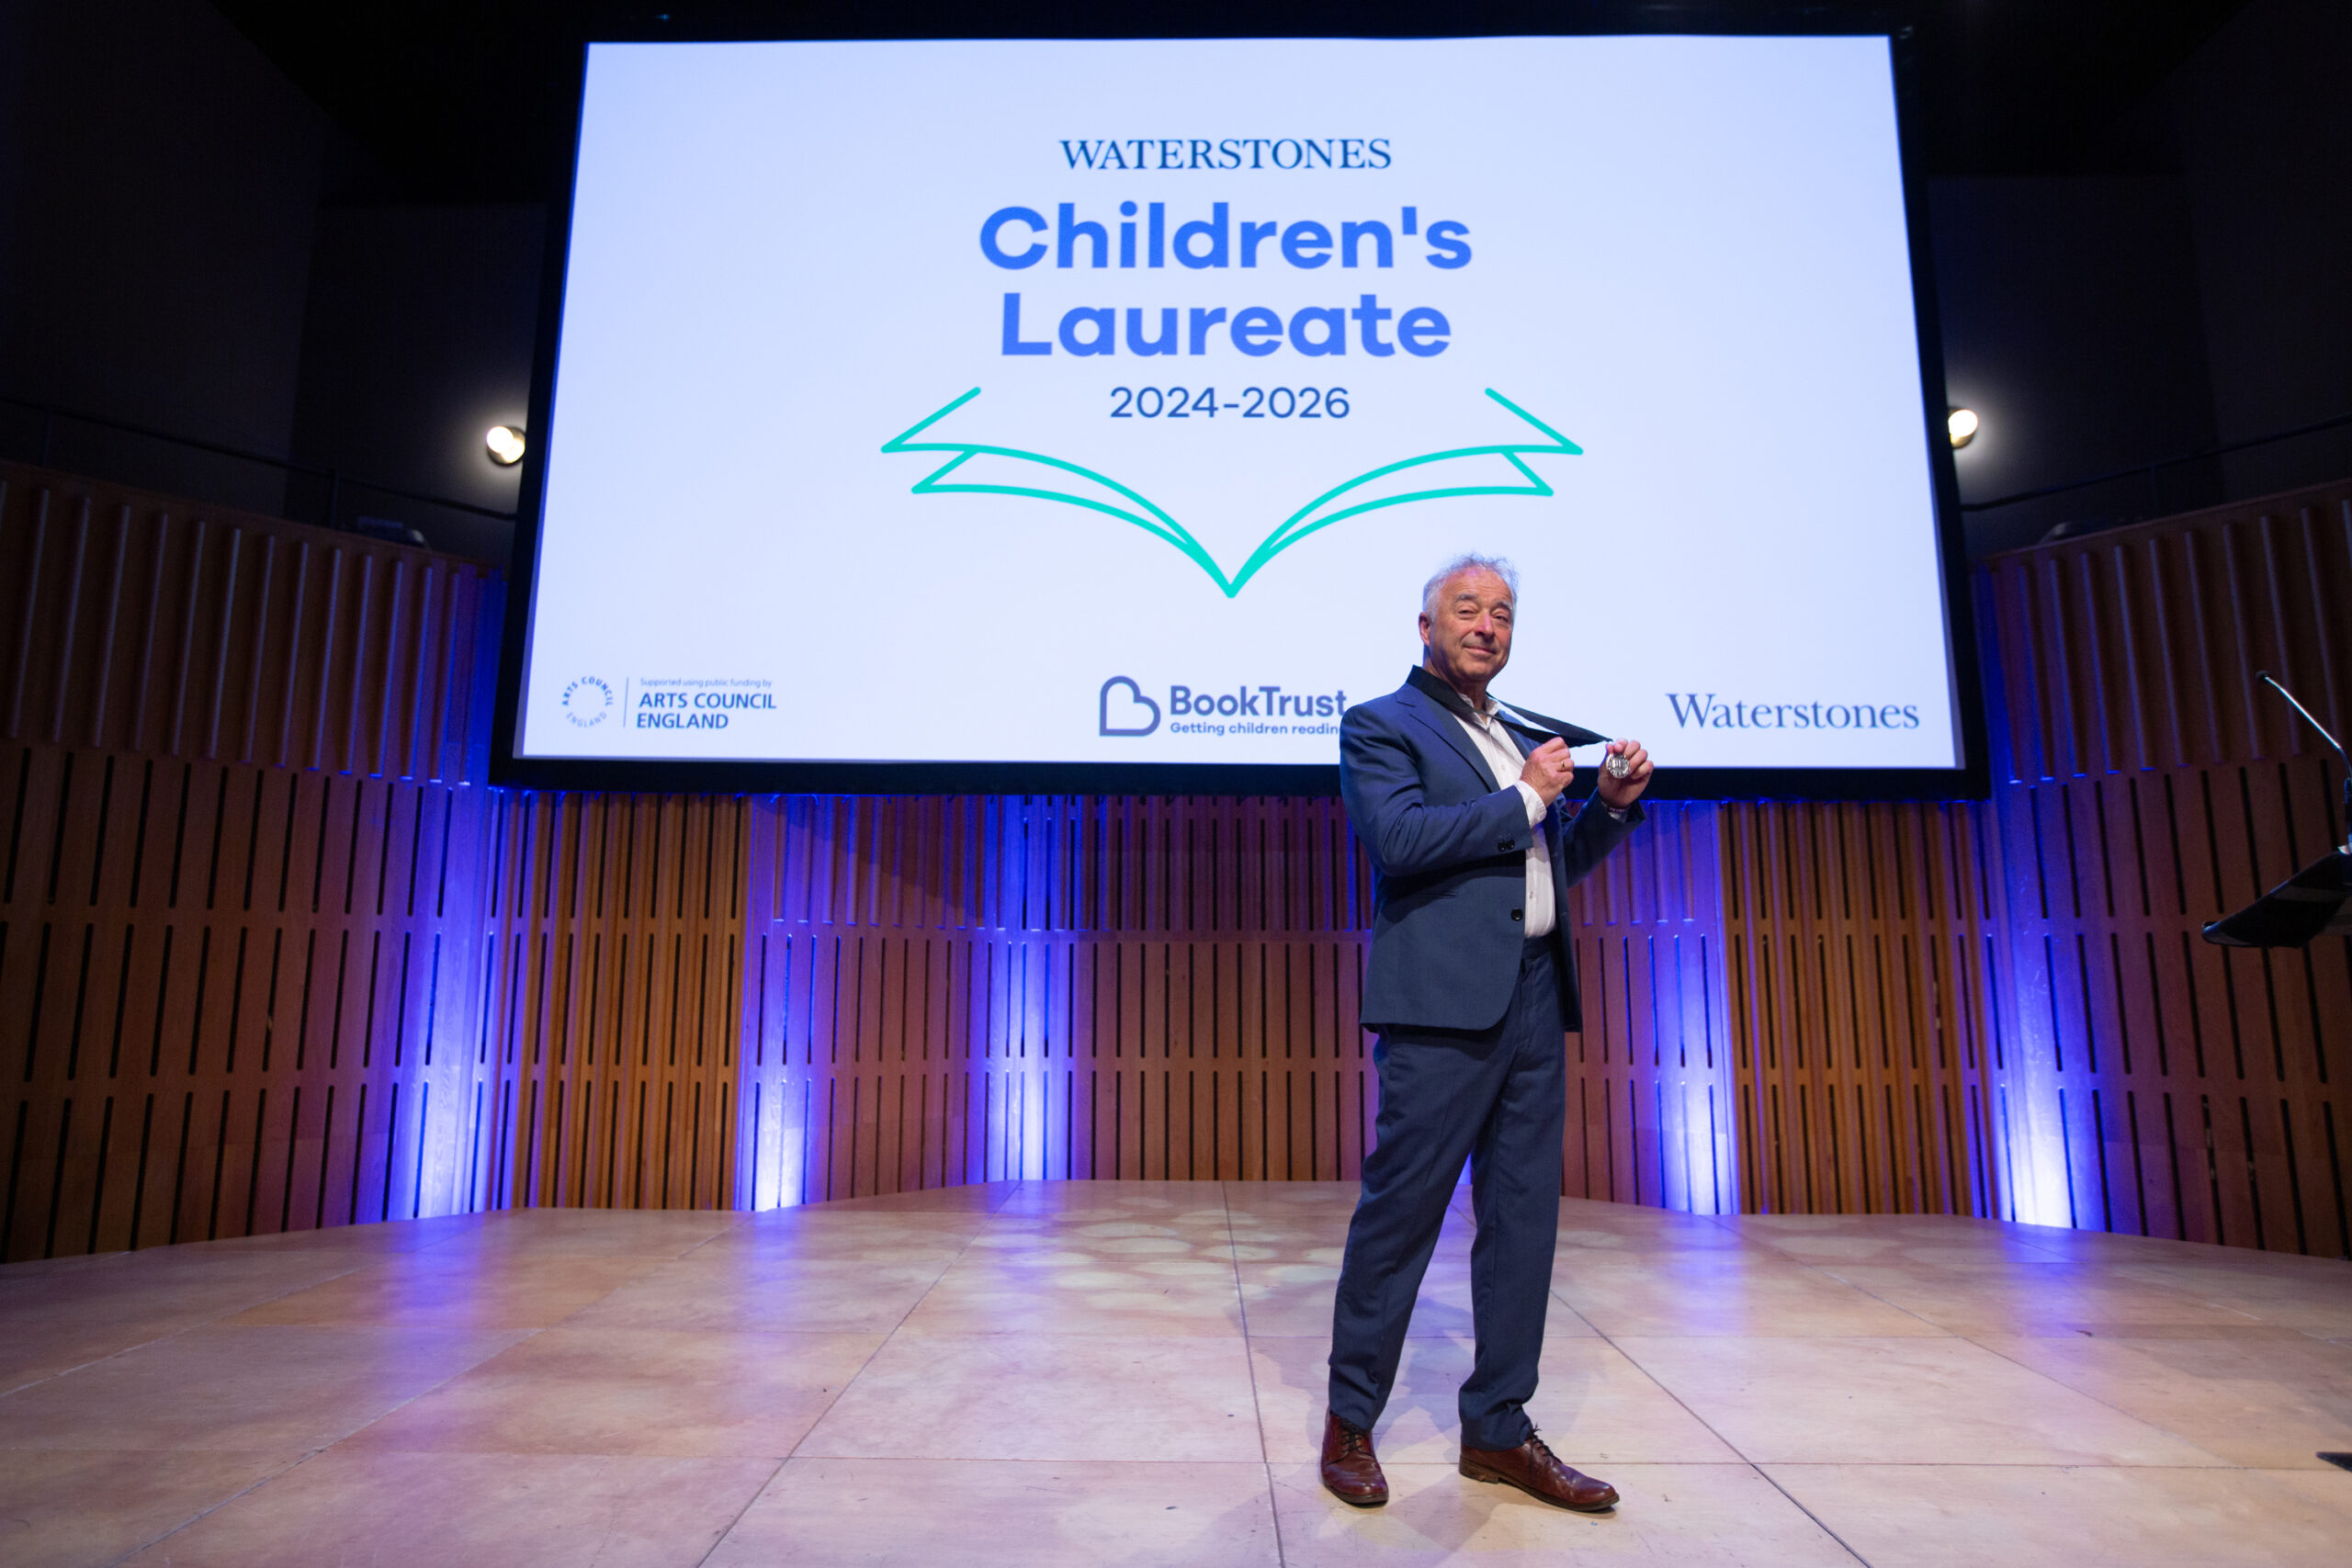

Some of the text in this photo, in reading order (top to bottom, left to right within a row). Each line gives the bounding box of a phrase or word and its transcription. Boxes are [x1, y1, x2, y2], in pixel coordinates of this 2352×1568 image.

[1059, 138, 1392, 170] WATERSTONES
[979, 200, 1473, 270] Children's
[1001, 292, 1452, 358] Laureate
[1110, 386, 1351, 420] 2024-2026
[561, 676, 614, 706] ARTS COUNCIL
[639, 678, 773, 689] Supported using public funding by
[639, 693, 777, 709] ARTS COUNCIL
[1170, 685, 1347, 716] BookTrust
[1666, 694, 1920, 729] Waterstones
[637, 713, 729, 728] ENGLAND
[1170, 722, 1339, 737] Getting children readin
